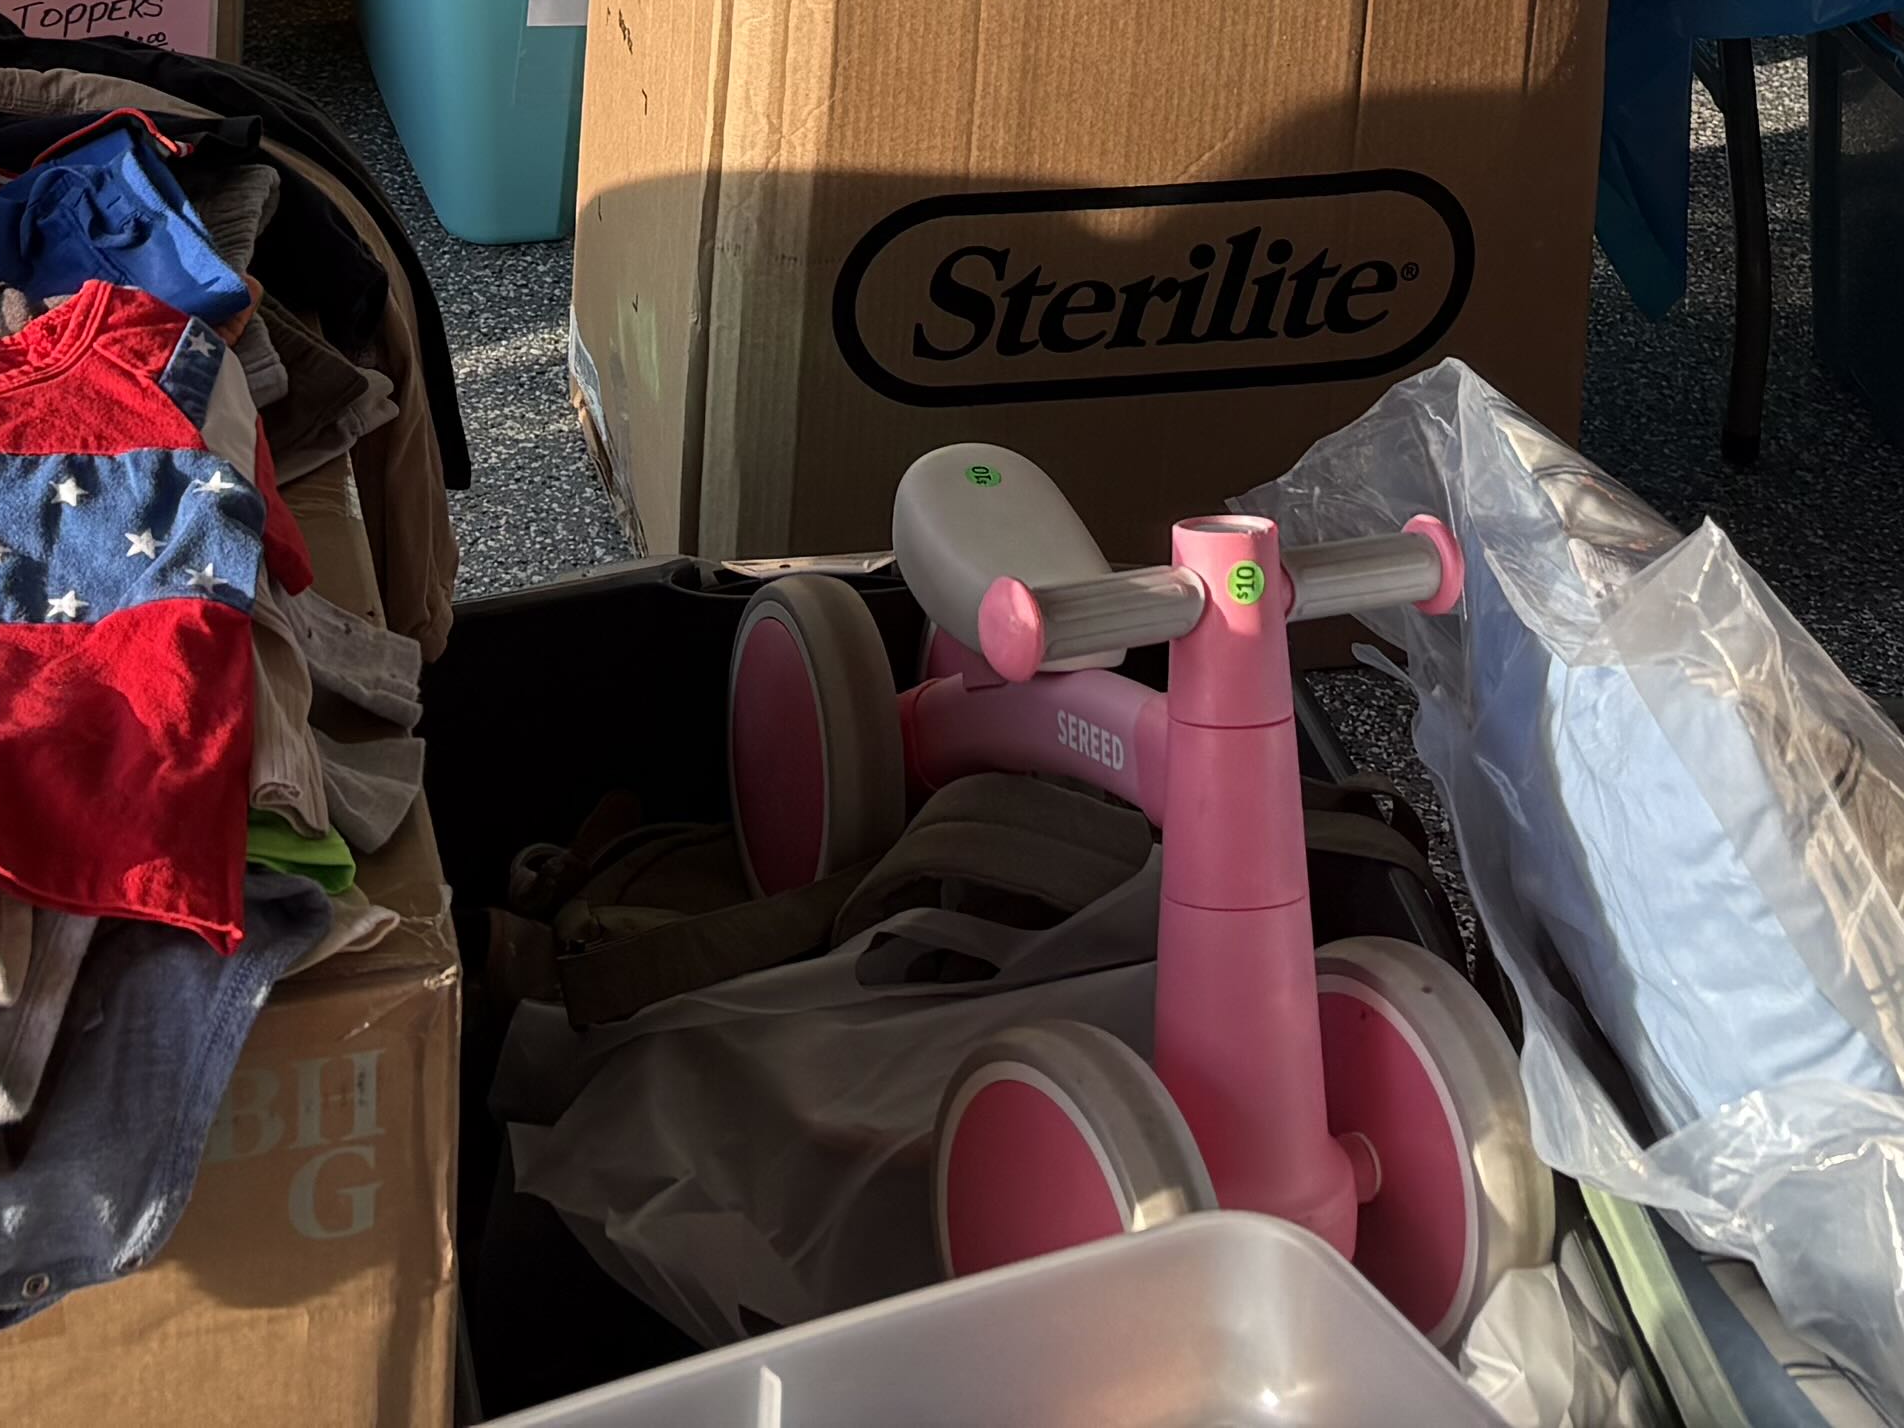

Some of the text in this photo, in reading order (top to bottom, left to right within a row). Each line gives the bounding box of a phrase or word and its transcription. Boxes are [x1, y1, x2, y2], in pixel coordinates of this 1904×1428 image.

[972, 465, 993, 486] $10
[1235, 565, 1257, 601] $10
[1056, 709, 1125, 773] SEREED
